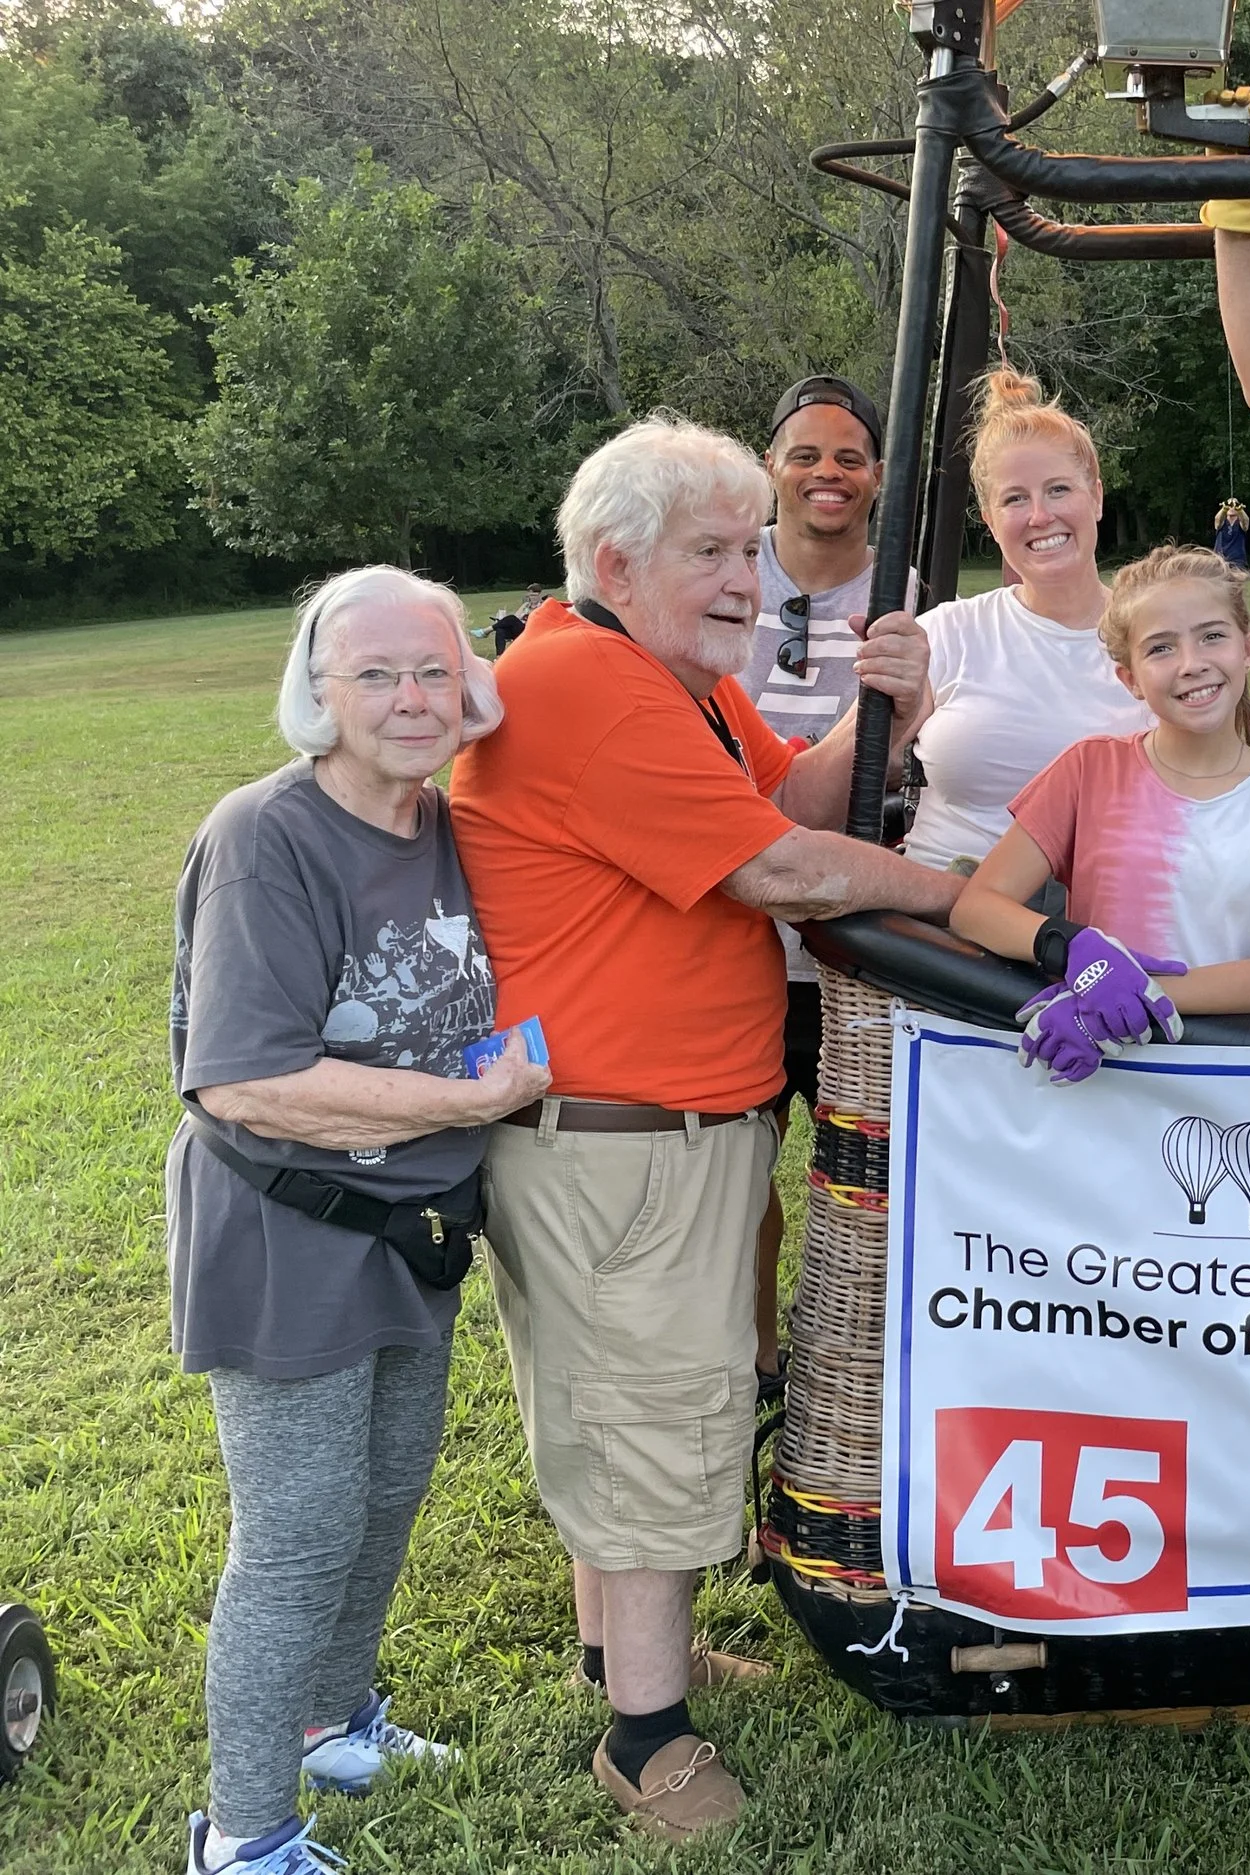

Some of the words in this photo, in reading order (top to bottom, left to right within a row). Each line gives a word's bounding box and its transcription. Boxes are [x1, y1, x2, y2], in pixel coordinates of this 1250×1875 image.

[953, 1231, 1049, 1279] The
[928, 1286, 1187, 1349] Chamber
[952, 1439, 1166, 1591] 45
